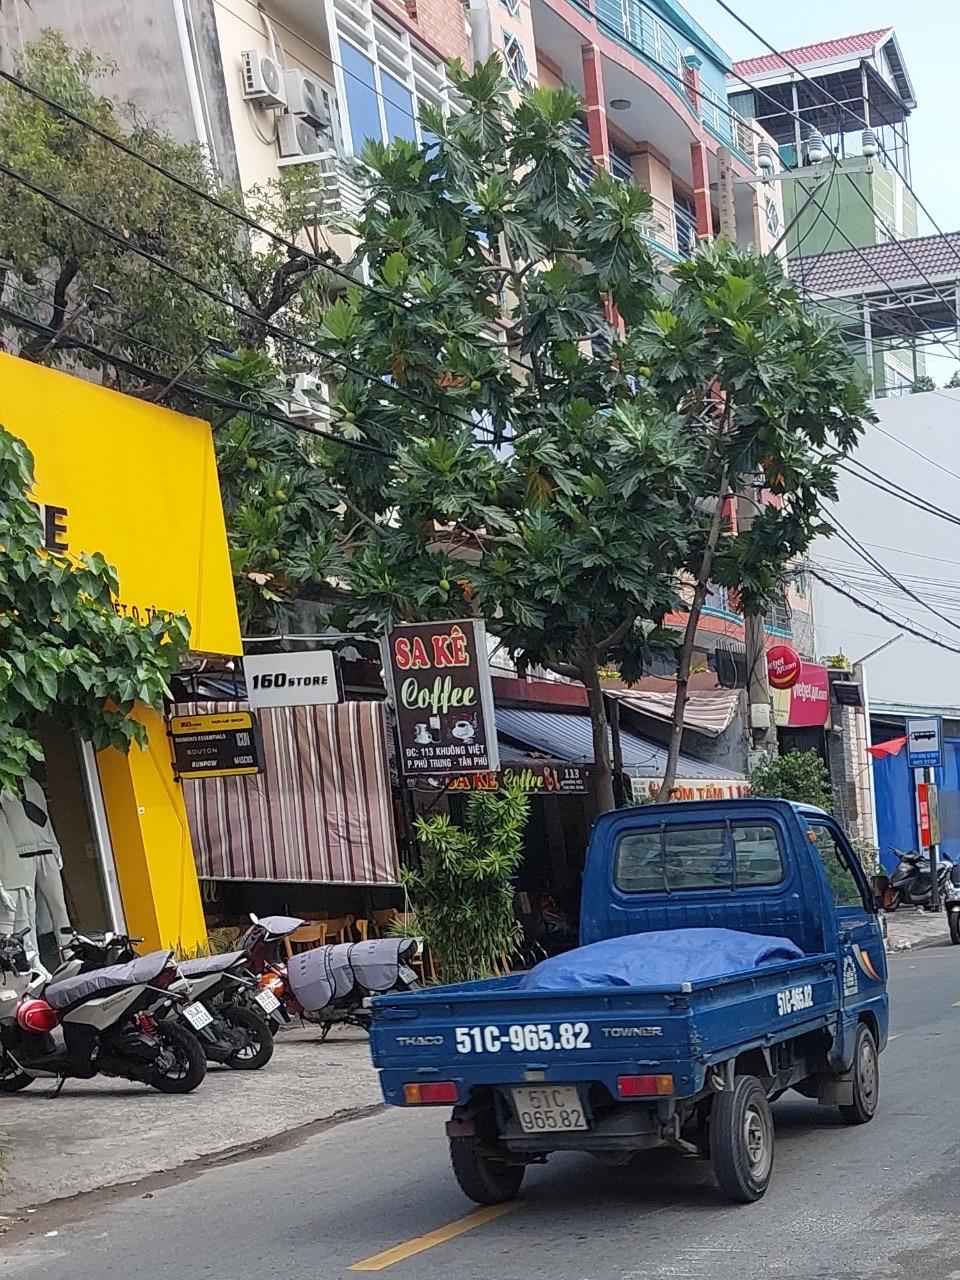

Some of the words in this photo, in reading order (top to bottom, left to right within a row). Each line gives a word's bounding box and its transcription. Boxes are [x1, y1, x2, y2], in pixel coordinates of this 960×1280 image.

[395, 636, 431, 670] SA
[431, 625, 469, 668] KÊ
[252, 673, 329, 690] 160STORE
[401, 675, 478, 714] Coffee
[186, 747, 218, 756] BOUTON
[405, 747, 419, 758] ĐC:
[420, 746, 434, 757] 113
[435, 744, 466, 756] KHUÔNG
[467, 743, 485, 755] VIỆT
[429, 758, 452, 768] TRUNG
[458, 755, 473, 767] TÂN
[473, 754, 488, 766] PHÚ
[564, 769, 580, 779] 113
[696, 783, 725, 800] TẤM
[396, 1036, 444, 1046] THACO
[455, 1022, 592, 1053] 51C-965.82
[601, 1027, 663, 1038] TOWNER
[529, 1090, 564, 1109] 51C
[522, 1110, 586, 1130] 965.82
